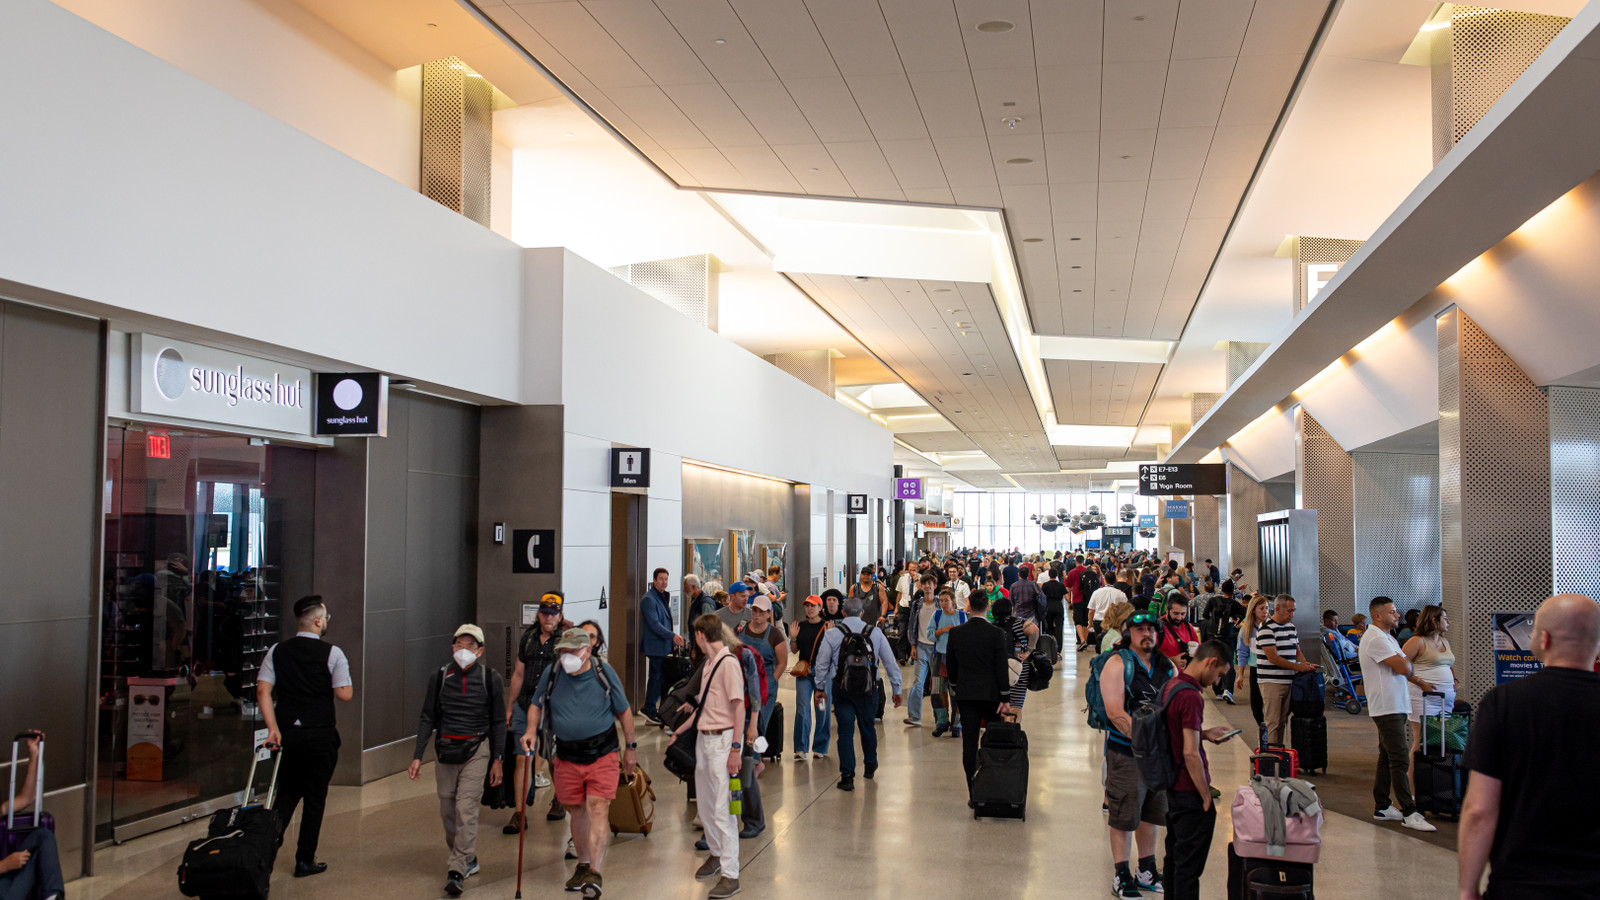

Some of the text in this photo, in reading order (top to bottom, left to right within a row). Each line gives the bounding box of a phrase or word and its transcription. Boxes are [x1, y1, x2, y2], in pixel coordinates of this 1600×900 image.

[190, 365, 303, 409] sunglass hut
[326, 415, 368, 426] sunglass hut
